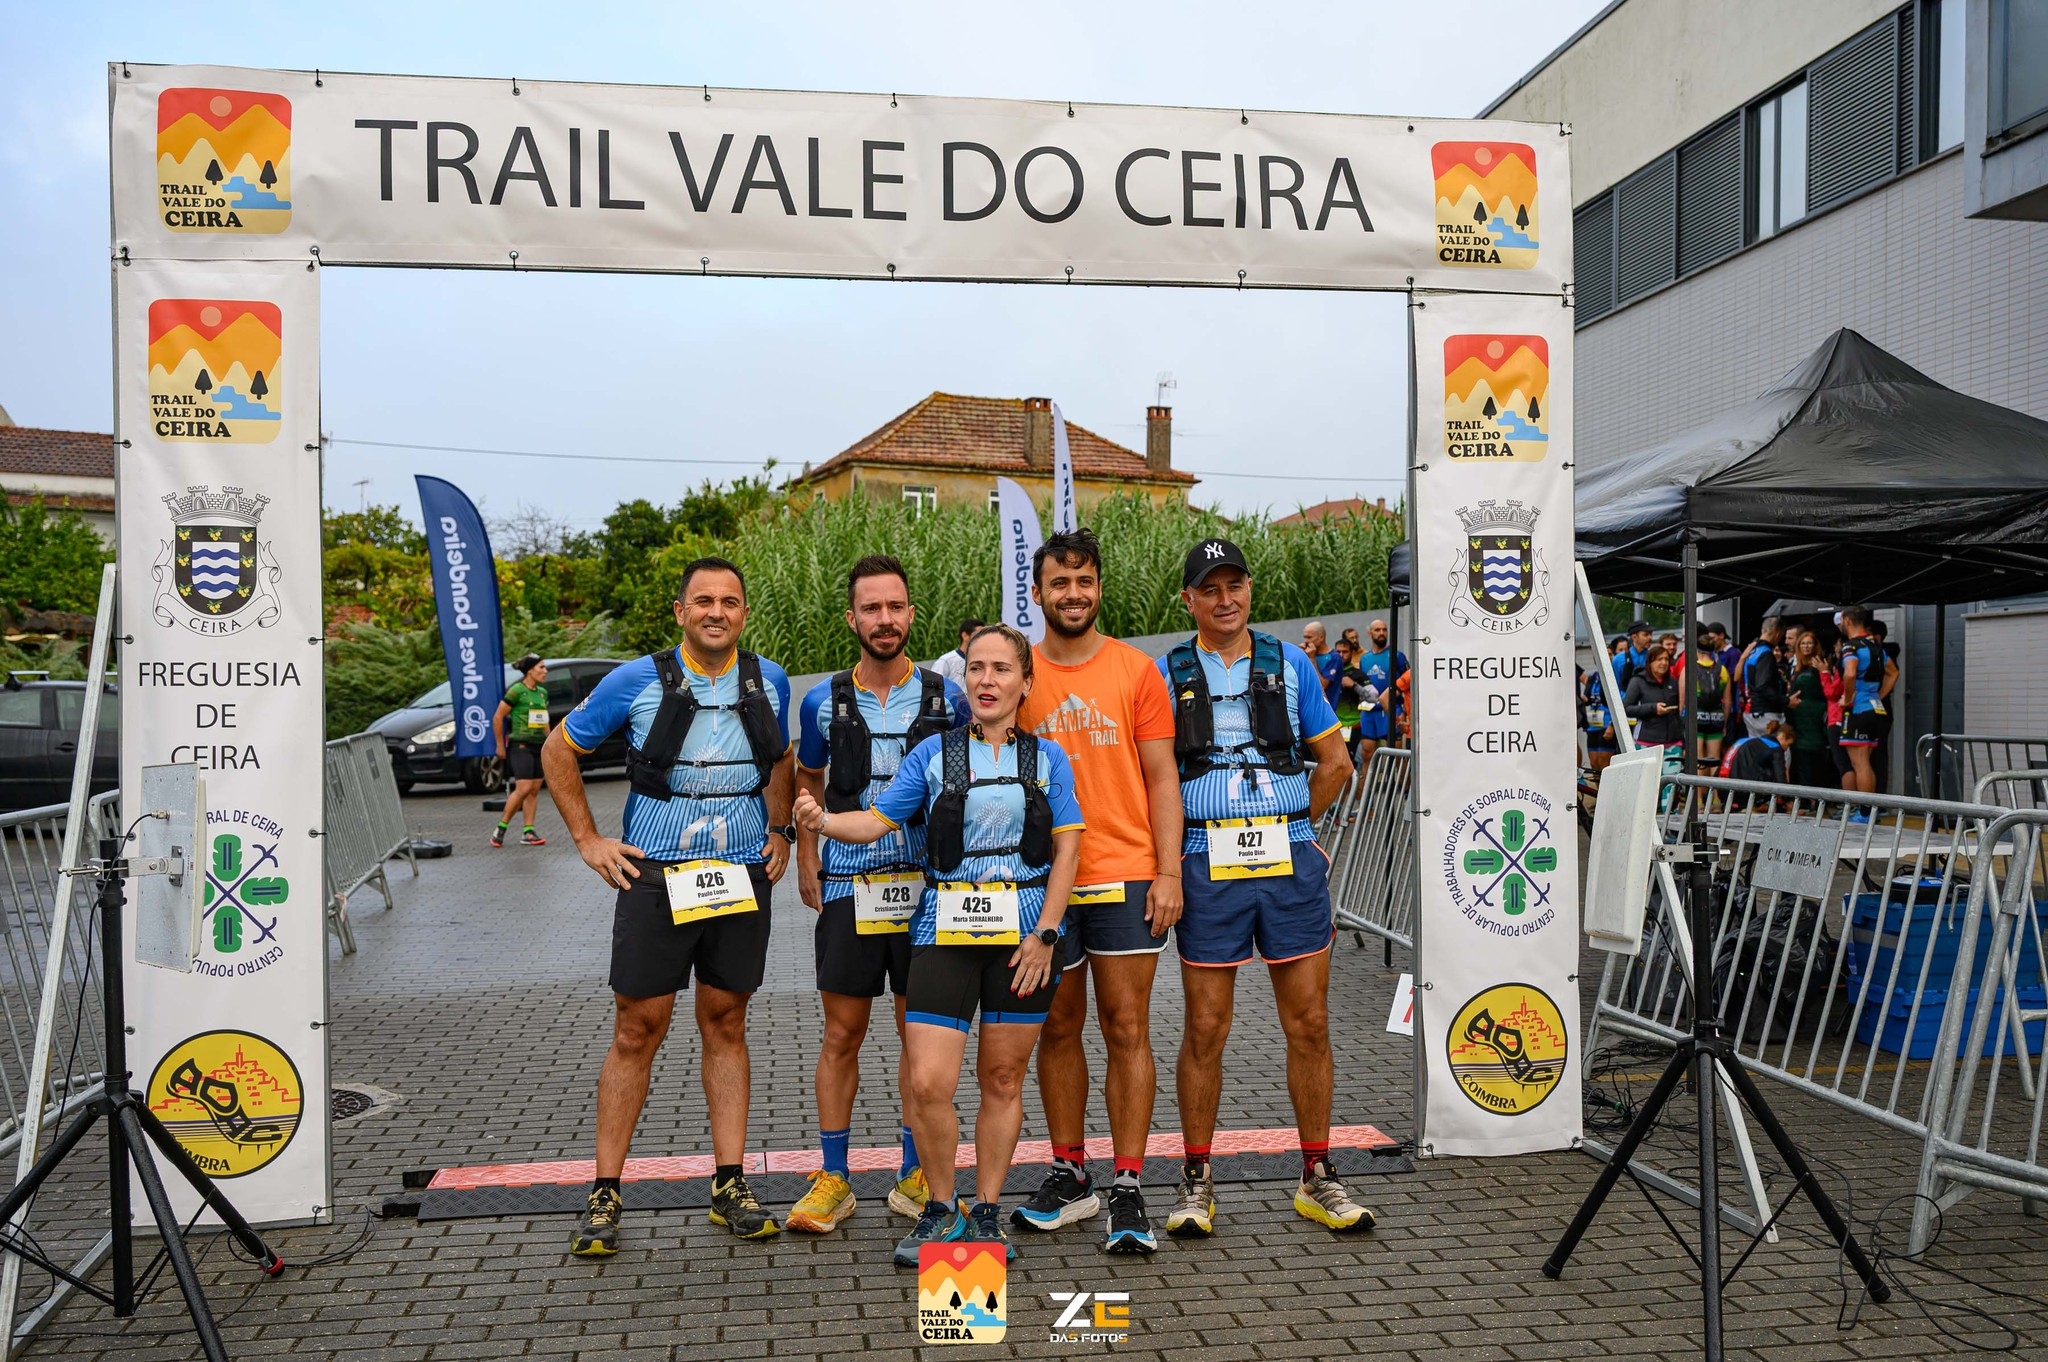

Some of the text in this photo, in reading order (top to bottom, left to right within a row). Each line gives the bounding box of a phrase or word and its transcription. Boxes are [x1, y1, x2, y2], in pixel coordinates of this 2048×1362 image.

[355, 118, 1375, 232] TRAIL VALE DO CEIRA
[160, 184, 207, 195] TRAIL
[162, 197, 226, 208] VALE DO
[165, 211, 243, 227] CEIRA
[1437, 224, 1475, 234] TRAIL
[1439, 236, 1490, 246] VALE DO
[1439, 248, 1502, 263] CEIRA
[151, 395, 197, 405] TRAIL
[153, 408, 216, 418] VALE DO
[155, 421, 232, 437] CEIRA
[1447, 421, 1484, 430] TRAIL
[1447, 431, 1501, 441] VALE DO
[1448, 442, 1514, 457] CEIRA
[1204, 542, 1226, 559] NY
[189, 617, 242, 633] CEIRA
[1481, 617, 1524, 632] CEIRA
[138, 662, 302, 687] FREGUESIA
[1433, 656, 1562, 680] FREGUESIA
[1487, 693, 1521, 717] DE
[196, 703, 237, 729] DE
[1089, 729, 1120, 747] TRAIL
[1467, 730, 1537, 754] CEIRA
[171, 745, 261, 770] CEIRA
[206, 809, 284, 840] RAL DE CEIRA
[1237, 831, 1263, 848] 427
[1238, 849, 1254, 857] Paulo
[1784, 850, 1822, 869] COIMBRA
[1443, 788, 1555, 937] CENTRO POPULAR DE TRABALHADORES DE SOBRAL DE CEIRA
[696, 871, 725, 889] 426
[697, 887, 729, 899] Paulo Lopes
[882, 887, 911, 903] 428
[874, 905, 898, 913] Cristiano
[962, 897, 992, 913] 425
[193, 946, 284, 977] CENTRO POPUL
[1462, 1073, 1518, 1109] COIMBRA
[184, 1148, 231, 1171] MBRA
